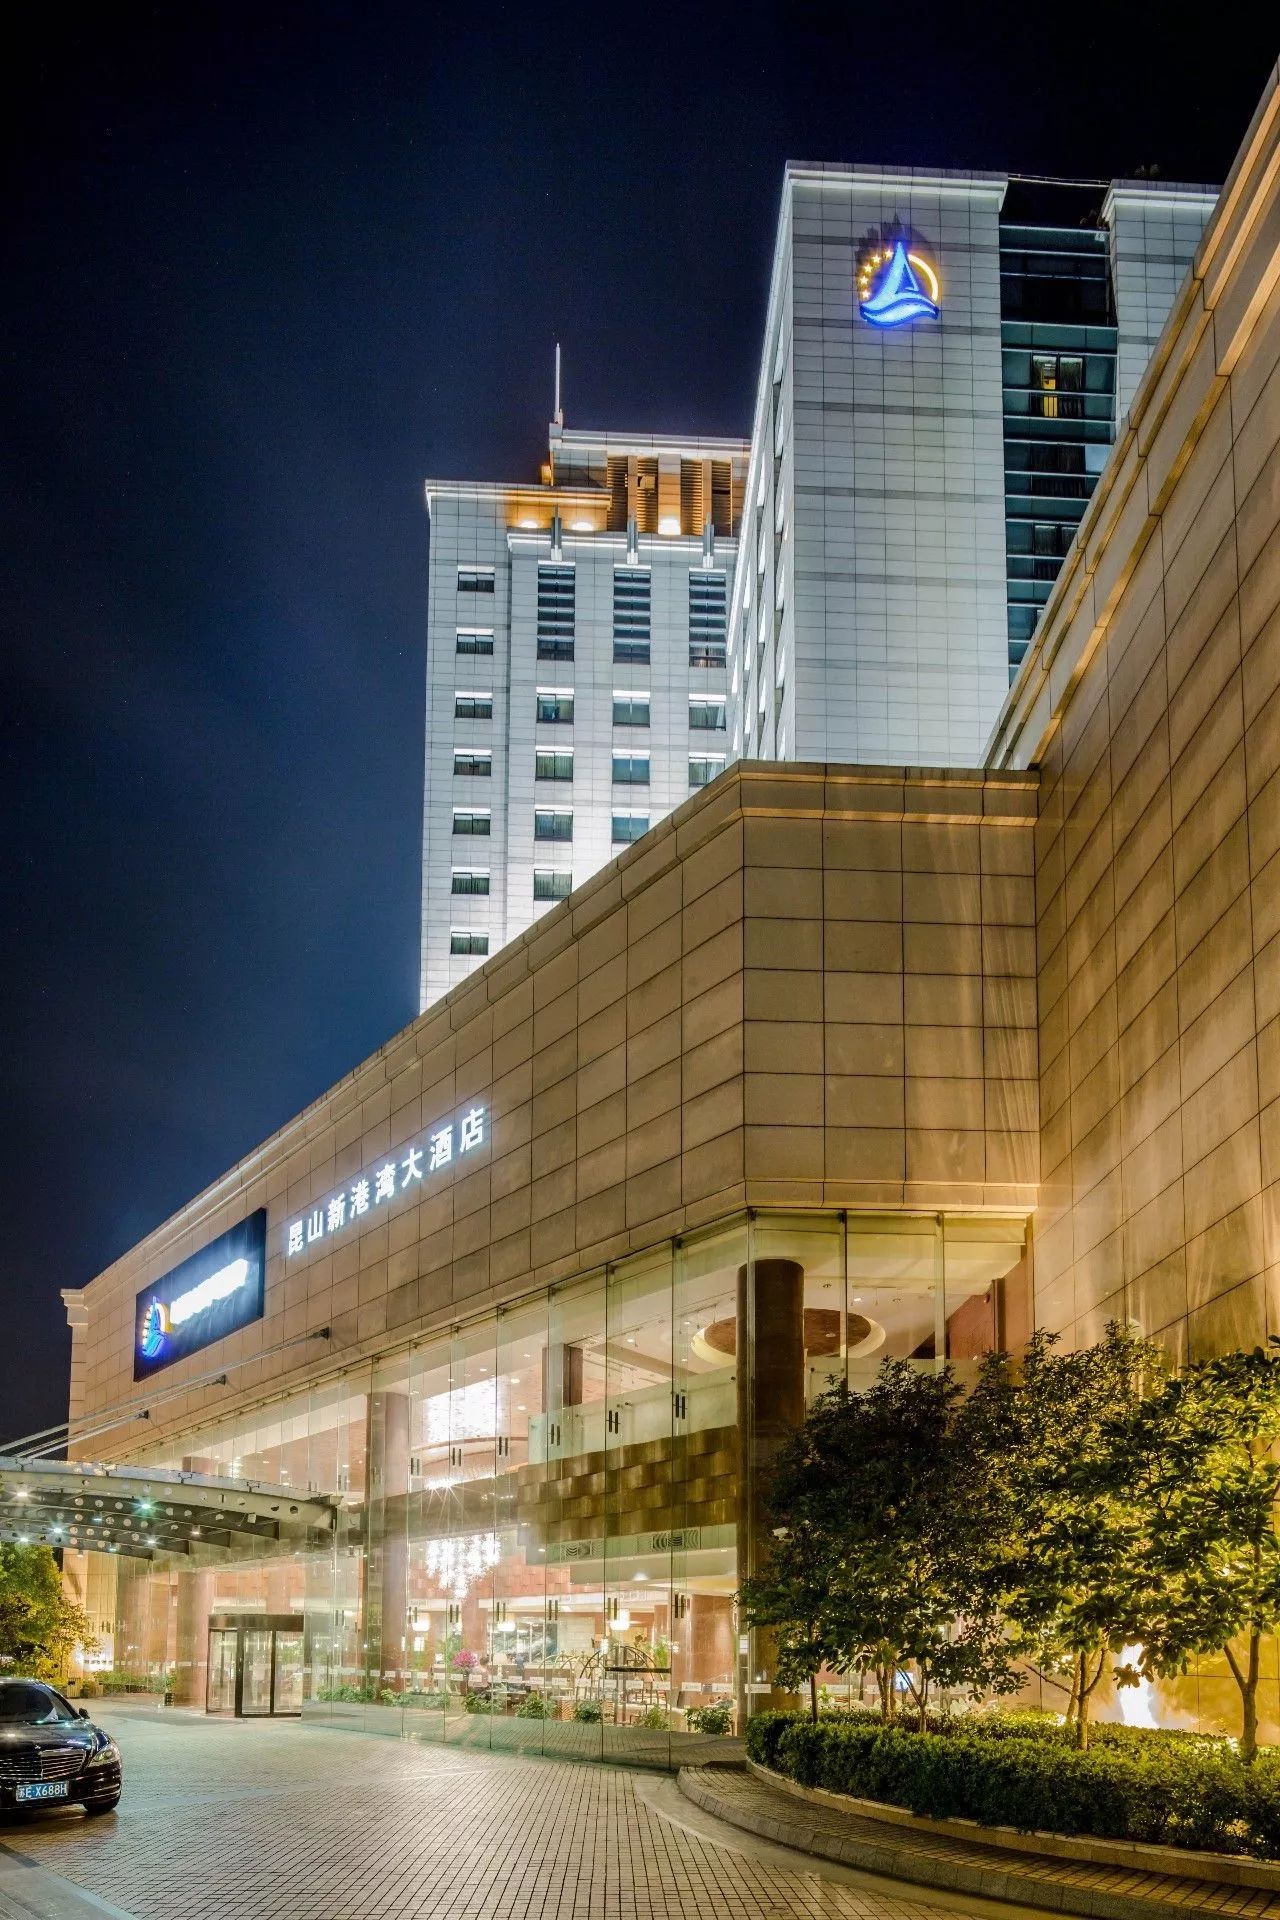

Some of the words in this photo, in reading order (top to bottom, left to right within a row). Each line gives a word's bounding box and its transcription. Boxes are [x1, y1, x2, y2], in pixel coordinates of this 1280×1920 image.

[288, 1107, 485, 1257] 昆山新港湾大酒店
